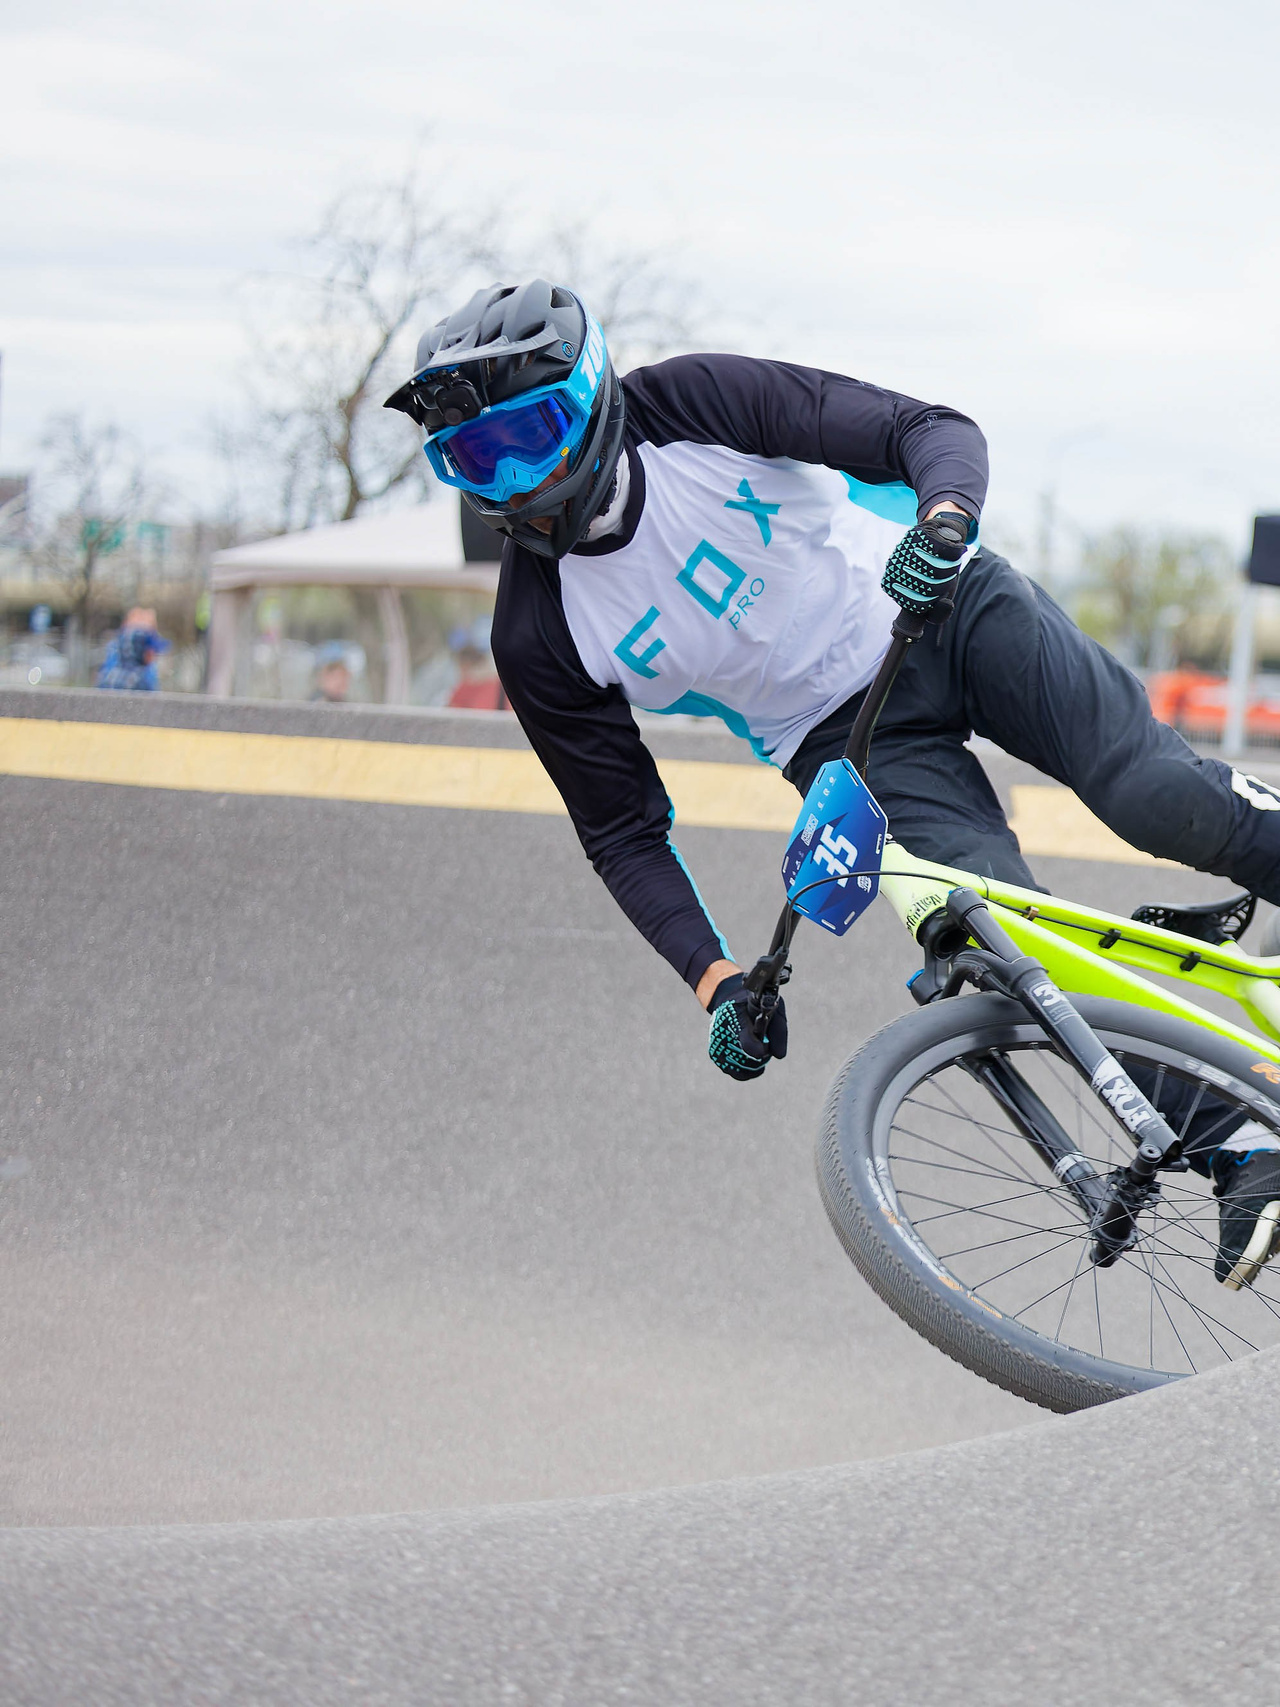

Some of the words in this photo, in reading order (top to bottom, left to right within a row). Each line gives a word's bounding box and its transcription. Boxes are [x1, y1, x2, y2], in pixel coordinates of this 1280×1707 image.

[613, 477, 782, 679] FOX
[728, 577, 765, 630] PRO
[813, 823, 858, 888] 35
[1101, 1077, 1153, 1133] FOX
